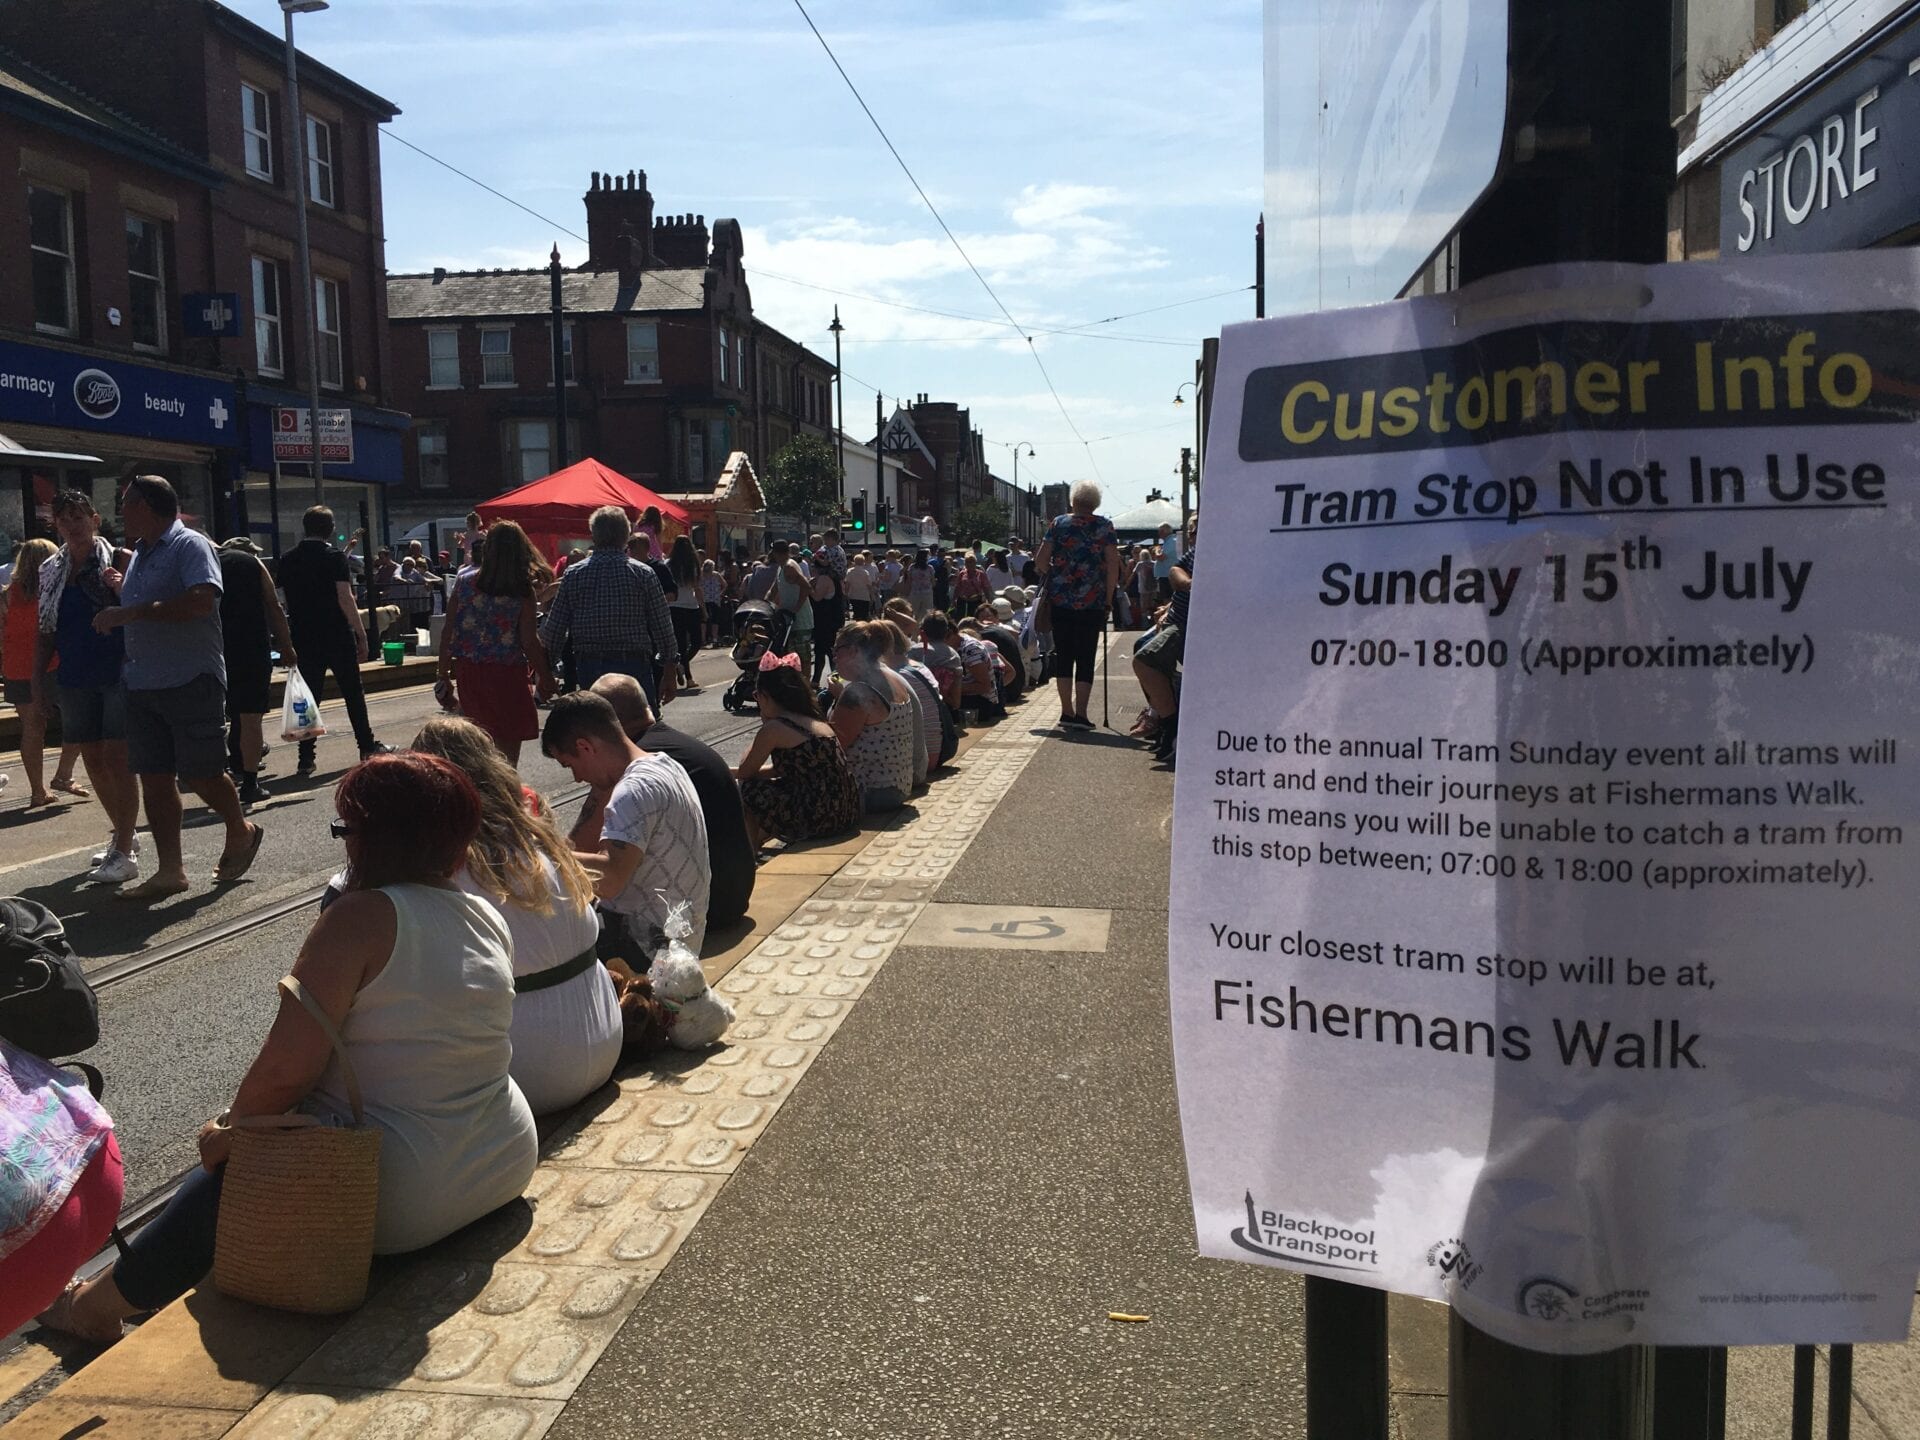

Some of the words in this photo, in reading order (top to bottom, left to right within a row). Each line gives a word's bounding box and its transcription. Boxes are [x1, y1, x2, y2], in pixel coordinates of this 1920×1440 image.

[1738, 86, 1881, 252] STORE
[0, 373, 55, 397] armacy
[84, 380, 116, 404] Boots
[145, 393, 185, 417] beauty
[1280, 361, 1660, 445] Customer
[1697, 331, 1874, 413] Info
[277, 445, 299, 455] 0161
[323, 446, 348, 456] 2852
[1275, 484, 1397, 526] Tram
[1415, 470, 1538, 525] Stop
[1558, 459, 1669, 510] Not
[1691, 456, 1746, 504] In
[1767, 453, 1887, 502] Use
[1319, 555, 1522, 617] Sunday
[1544, 536, 1663, 604] 15th
[1682, 547, 1813, 612] July
[1310, 638, 1508, 668] 07:00-18:00
[1520, 634, 1815, 674] (Approximately)
[1217, 730, 1258, 752] Due
[1265, 734, 1287, 753] to
[1294, 733, 1331, 756] the
[1339, 737, 1423, 759] annual
[1431, 738, 1500, 762] Tram
[1509, 741, 1617, 770] Sunday
[1626, 745, 1705, 766] event
[1714, 740, 1746, 765] all
[1757, 743, 1839, 765] trams
[1849, 739, 1896, 765] will
[1215, 767, 1266, 788] start
[1273, 769, 1316, 790] and
[1324, 772, 1367, 794] end
[1375, 774, 1433, 797] their
[1438, 775, 1559, 808] journeys
[1569, 783, 1596, 804] at
[1606, 781, 1778, 806] Fishermans
[1786, 780, 1864, 805] Walk.
[1214, 800, 1260, 823] This
[1268, 806, 1346, 829] means
[1354, 814, 1398, 836] you
[1407, 812, 1449, 836] will
[1459, 814, 1491, 838] be
[1500, 819, 1596, 842] unable
[1605, 822, 1634, 844] to
[1643, 821, 1724, 845] catch
[1733, 827, 1749, 845] a
[1759, 822, 1825, 845] tram
[1836, 820, 1903, 844] from
[1213, 835, 1253, 857] this
[1260, 840, 1311, 867] stop
[1320, 842, 1432, 874] between;
[1441, 852, 1516, 878] 07:00
[1525, 856, 1544, 879] &
[1555, 858, 1633, 883] 18:00
[1643, 858, 1874, 888] (approximately).
[1210, 923, 1271, 952] Your
[1280, 930, 1384, 965] closest
[1393, 943, 1464, 974] tram
[1476, 953, 1548, 987] stop
[1559, 956, 1614, 984] will
[1627, 958, 1666, 986] be
[1676, 961, 1716, 990] at,
[1214, 979, 1531, 1062] Fishermans
[1553, 1018, 1706, 1069] Walk.
[1261, 1210, 1375, 1245] Blackpool
[1264, 1230, 1378, 1265] Transport
[1584, 1289, 1650, 1307] Corporate
